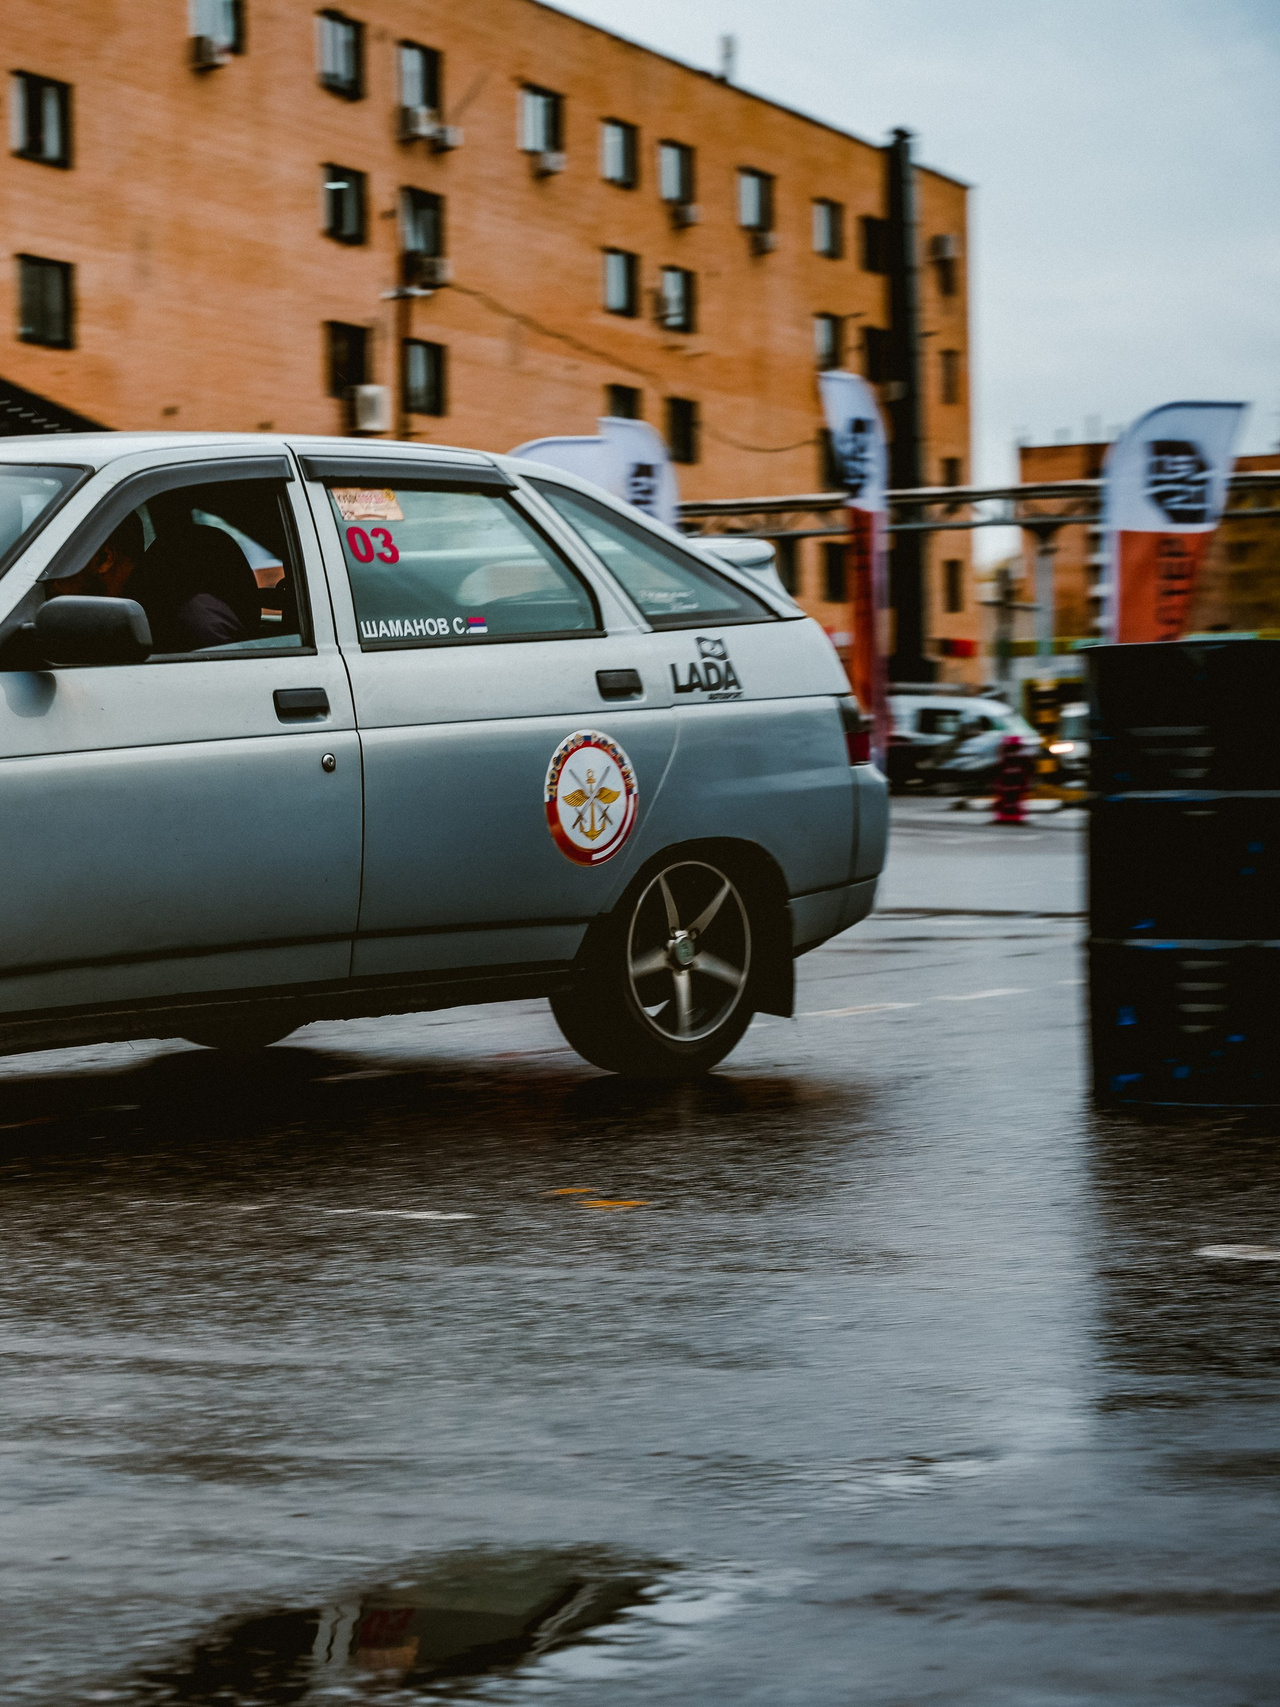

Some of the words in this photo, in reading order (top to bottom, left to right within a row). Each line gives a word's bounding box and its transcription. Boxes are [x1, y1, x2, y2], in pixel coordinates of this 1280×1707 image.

[345, 526, 400, 564] 03
[360, 617, 450, 638] ШАМАНОВ
[670, 660, 743, 694] LADA
